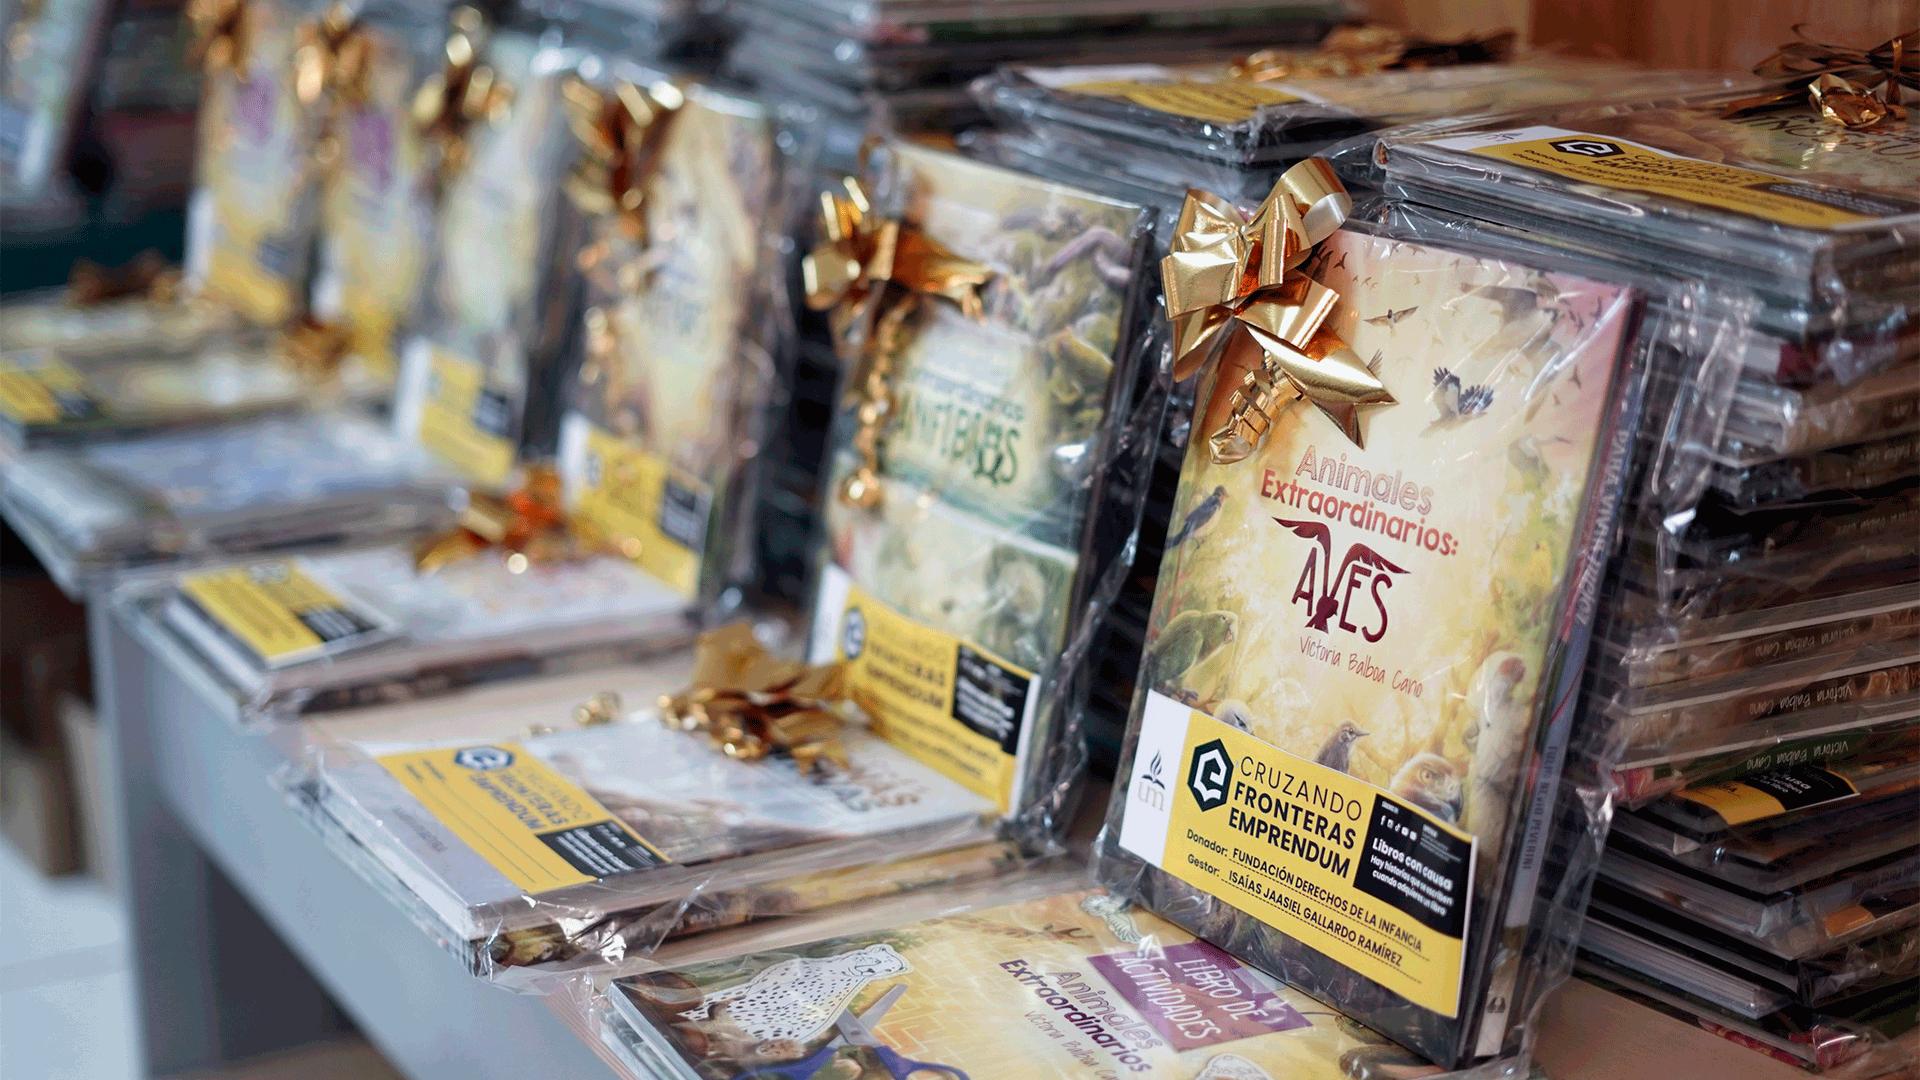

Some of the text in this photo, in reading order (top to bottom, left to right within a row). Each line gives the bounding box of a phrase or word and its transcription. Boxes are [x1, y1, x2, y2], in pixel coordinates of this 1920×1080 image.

[1261, 469, 1459, 556] Extraordinarios:
[1296, 445, 1434, 515] Animales
[1272, 517, 1411, 643] AVES
[1300, 637, 1423, 698] Victoria Balboa Cano
[1816, 681, 1853, 703] Victoria
[1780, 692, 1811, 713] Balboa
[1746, 739, 1849, 771] Victoria Balboa Cano
[1234, 781, 1357, 849] FRONTERAS
[1240, 756, 1362, 821] CRUZANDO
[1228, 807, 1351, 878] EMPRENDUM
[1370, 854, 1385, 870] Hay
[1384, 861, 1411, 883] historias
[1372, 837, 1405, 864] Libros
[1405, 855, 1423, 873] con
[1422, 866, 1454, 892] causa
[1187, 828, 1422, 952] Donador: FUNDACIÓN DERECHOS DE LA INFANCIA
[1187, 854, 1403, 967] Gestor: ISAÍAS JAASIEL GALLARDO RAMÍREZ
[1372, 869, 1397, 888] cuando
[999, 958, 1153, 1074] Extraordinarios
[1048, 968, 1163, 1051] Animales
[1113, 955, 1223, 1040] ACTIVIDADES
[1174, 958, 1268, 1021] LIBRO DE
[1024, 1010, 1065, 1039] Victoria
